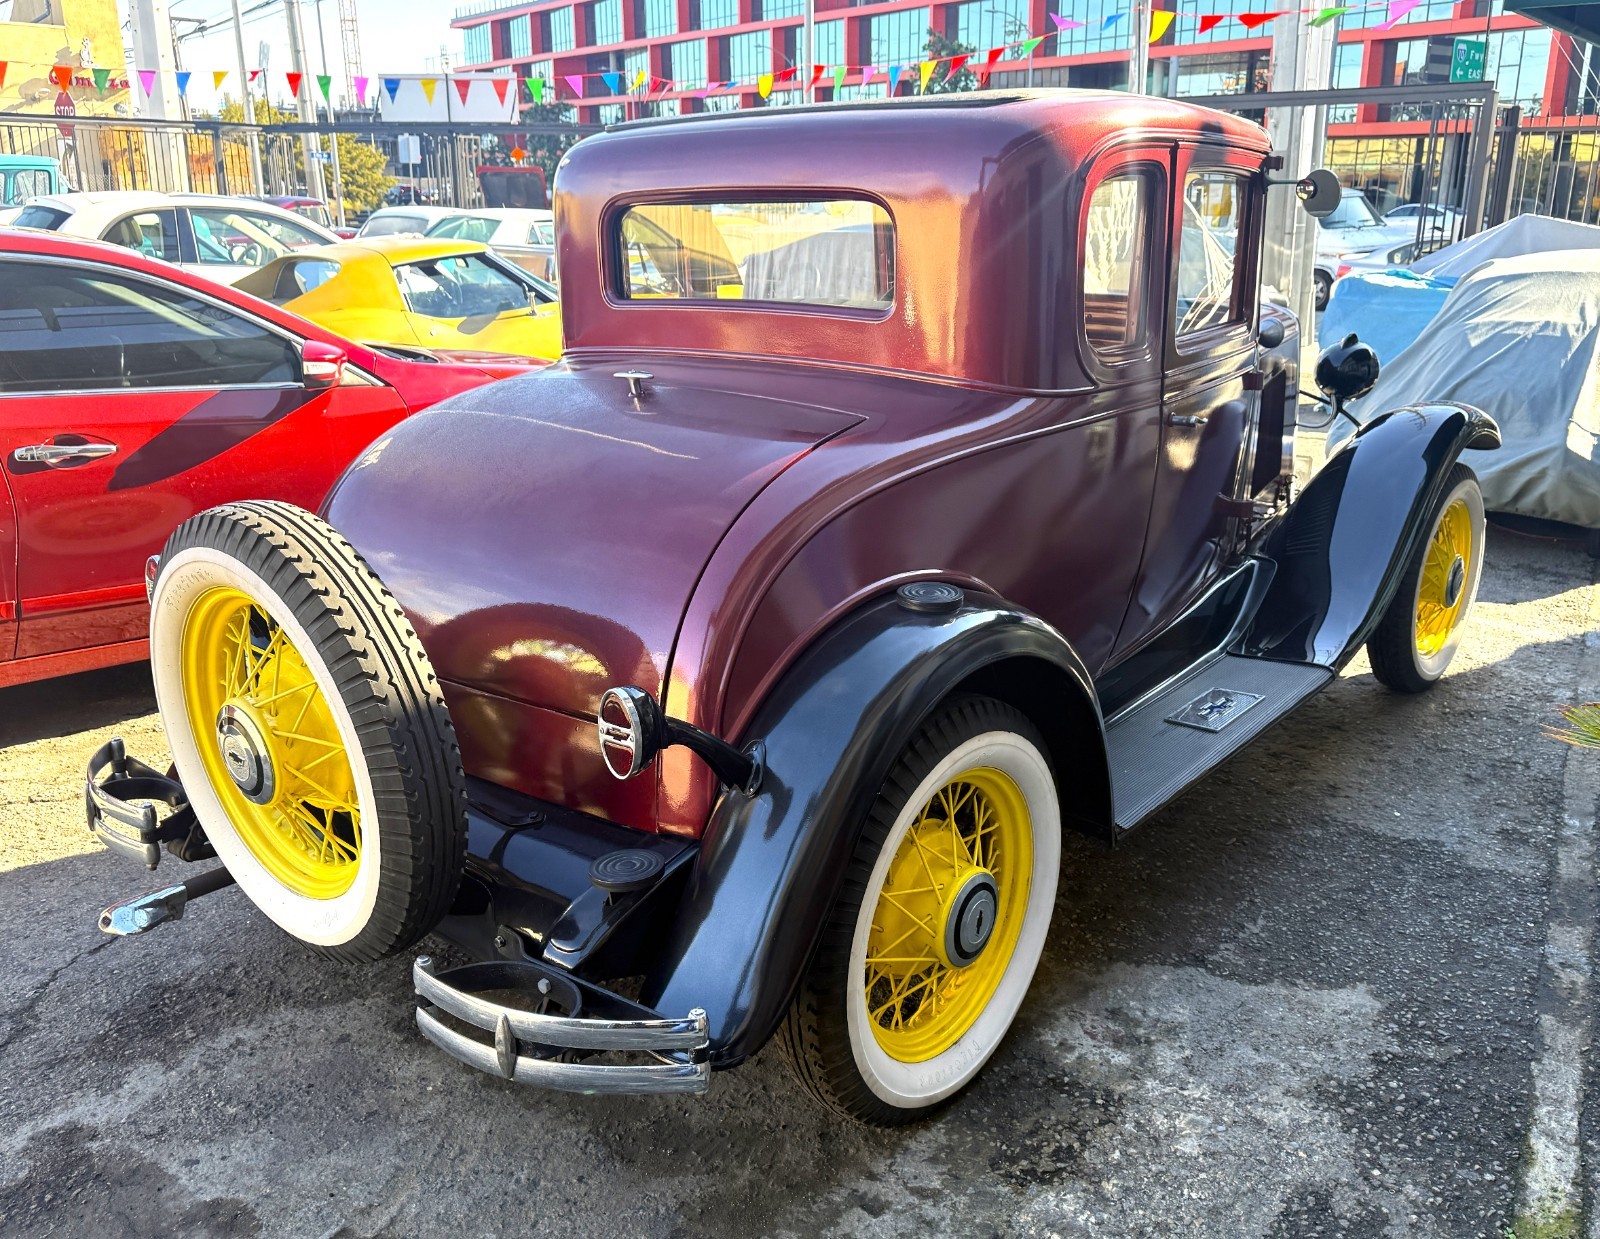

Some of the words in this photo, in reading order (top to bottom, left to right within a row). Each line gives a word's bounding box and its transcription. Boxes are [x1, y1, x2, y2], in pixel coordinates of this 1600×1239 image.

[1470, 50, 1484, 62] Fwy
[1468, 68, 1482, 79] EAS
[55, 105, 75, 116] STOP
